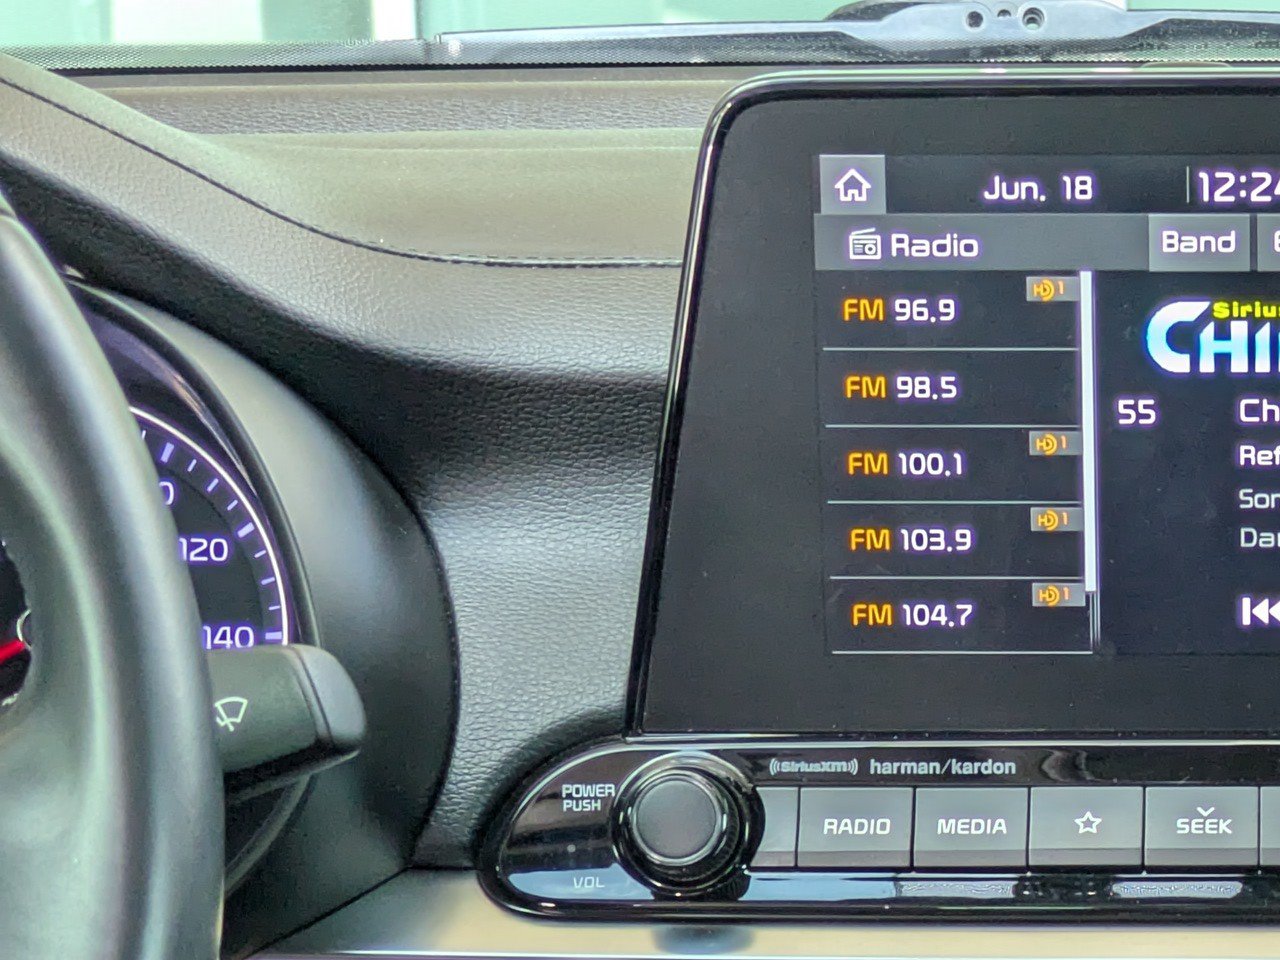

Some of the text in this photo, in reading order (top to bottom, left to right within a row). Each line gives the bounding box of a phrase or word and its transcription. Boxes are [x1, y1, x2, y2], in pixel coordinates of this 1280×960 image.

[983, 175, 1093, 202] Jun. 18
[890, 233, 979, 258] Radio
[1161, 230, 1237, 253] Band
[843, 299, 956, 323] FM 96.9
[845, 376, 957, 400] FM 98.5
[1117, 399, 1156, 425] 55
[847, 452, 963, 477] FM 100.1
[179, 538, 229, 561] 120
[850, 528, 973, 553] FM 103.9
[852, 604, 973, 628] FM 104.7
[203, 626, 255, 649] 140
[869, 758, 1017, 775] harman/kardon
[561, 783, 616, 798] POWER
[562, 798, 601, 812] PUSH
[822, 818, 891, 836] RADIO
[936, 818, 1008, 835] MEDIA
[1176, 817, 1233, 834] SEEK
[572, 876, 605, 889] VOL
